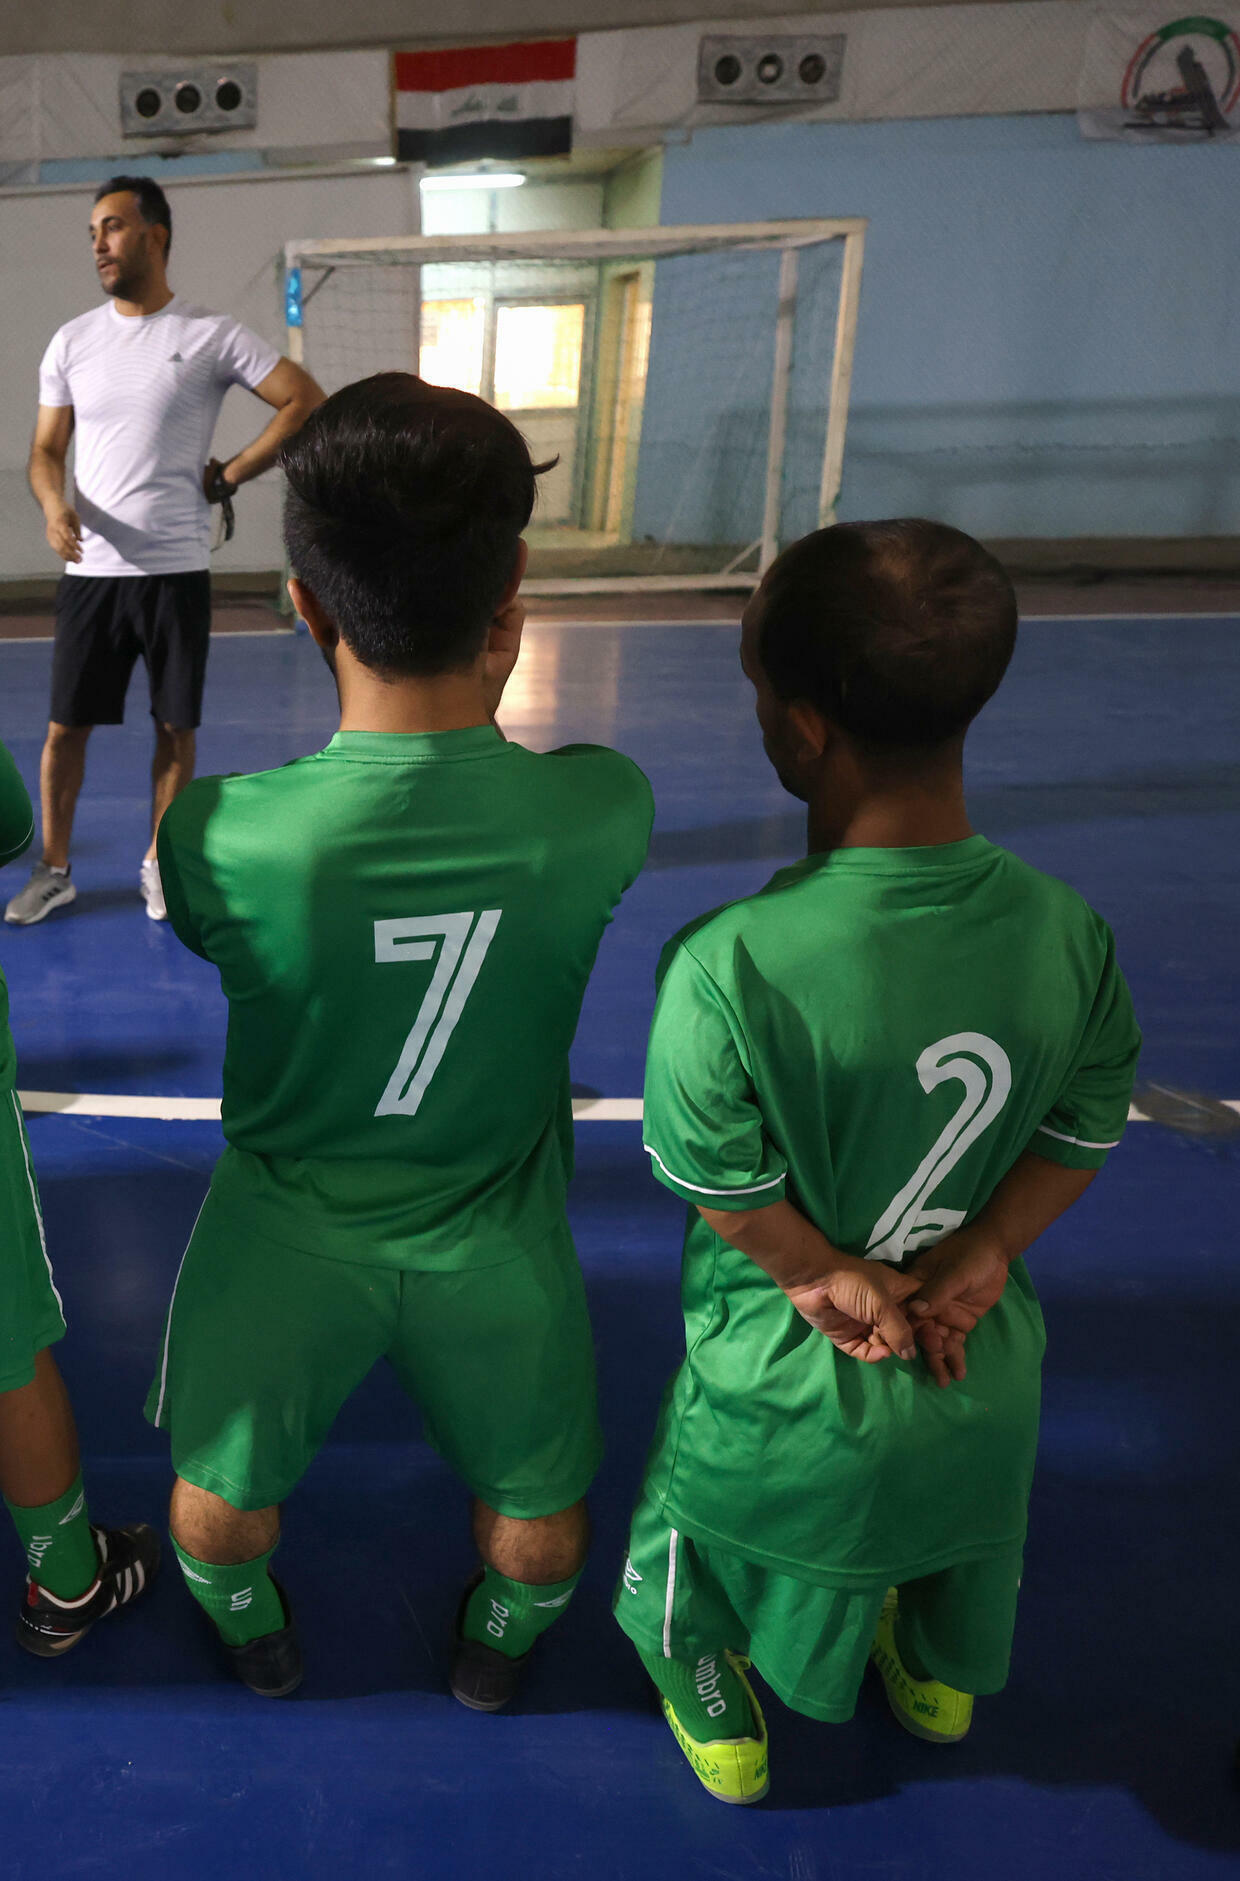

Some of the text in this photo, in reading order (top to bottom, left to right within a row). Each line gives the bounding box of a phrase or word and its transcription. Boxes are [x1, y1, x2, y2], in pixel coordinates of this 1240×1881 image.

[373, 908, 502, 1117] 7
[863, 1031, 1012, 1262] 2
[695, 1653, 727, 1718] umbro
[912, 1700, 940, 1719] NIKE
